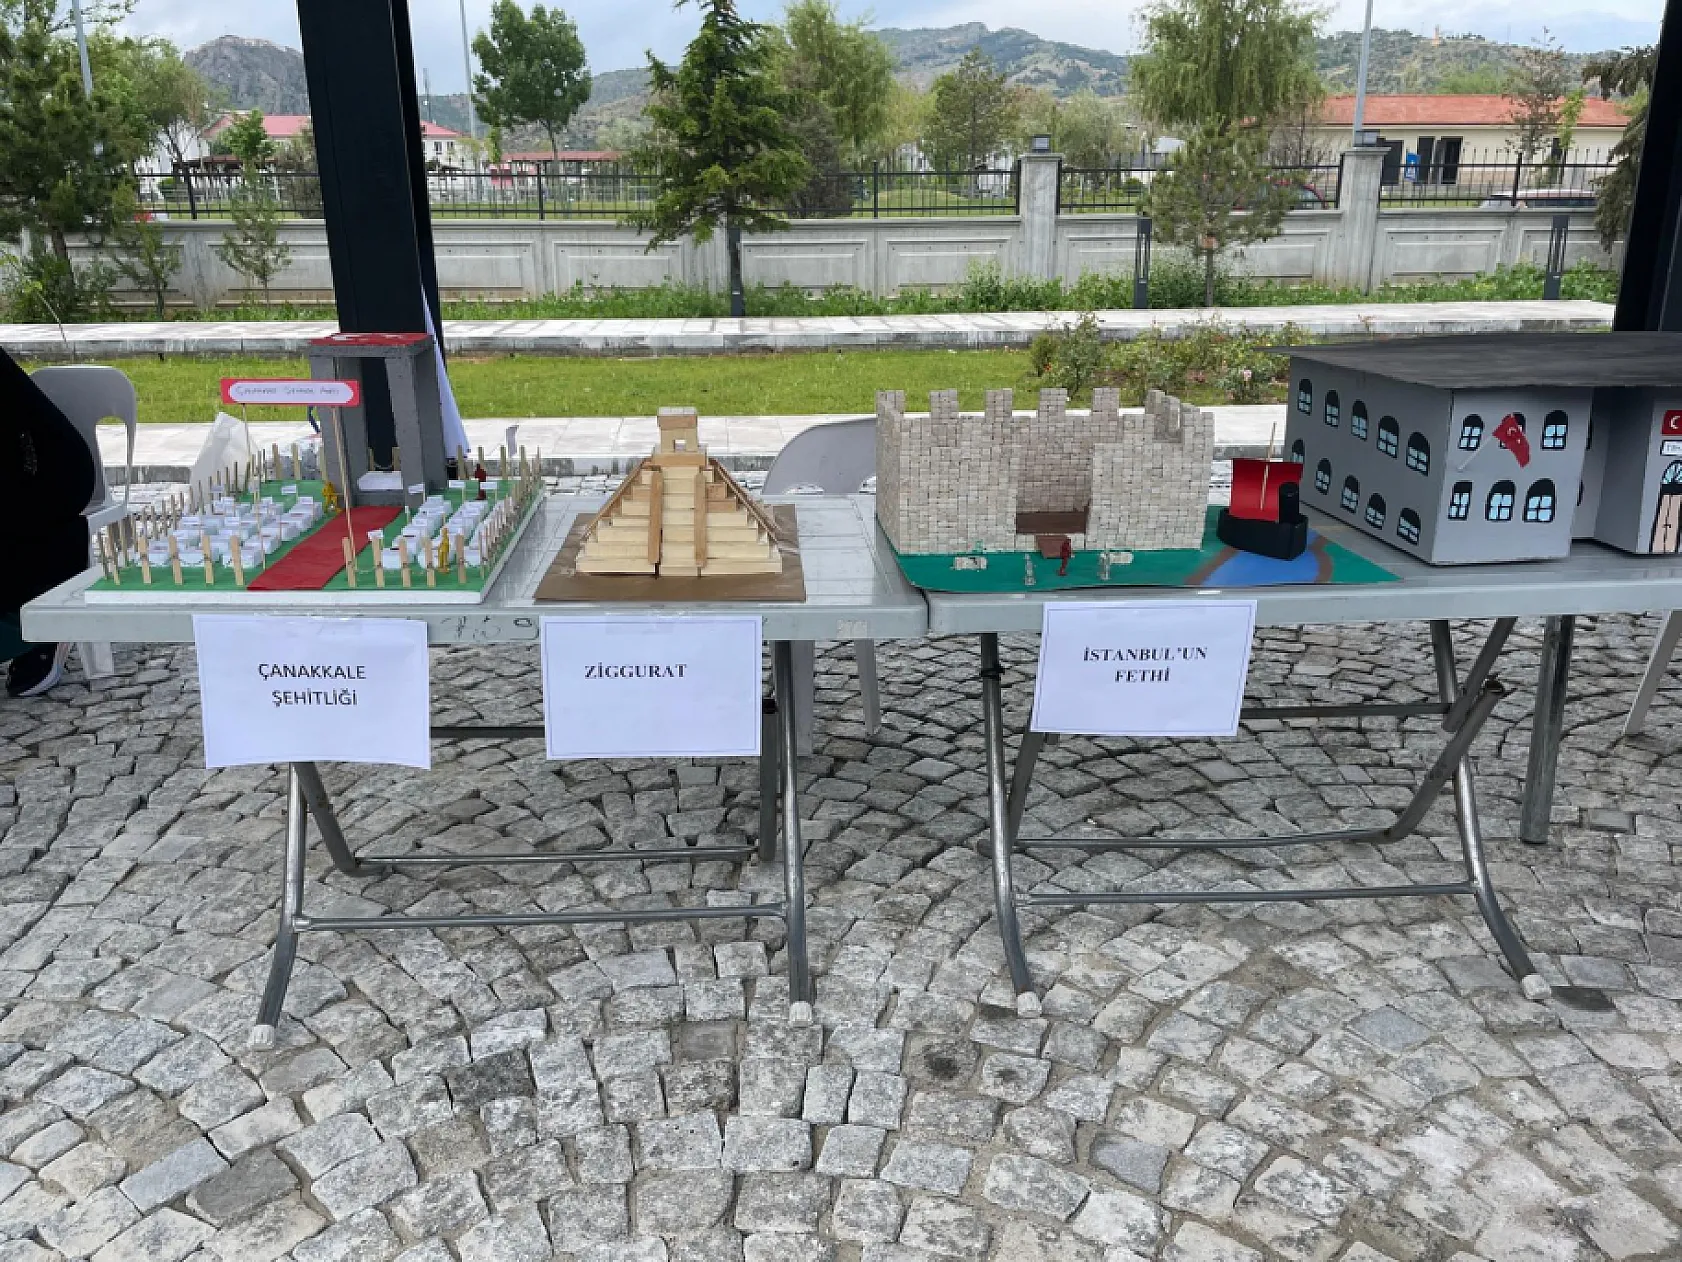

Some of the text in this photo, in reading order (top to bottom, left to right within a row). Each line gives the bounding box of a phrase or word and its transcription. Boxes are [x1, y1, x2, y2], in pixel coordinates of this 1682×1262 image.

[258, 663, 367, 681] ÇANAKKALE
[584, 661, 687, 679] ZİGGURAT
[1114, 666, 1171, 683] FETHİ
[272, 687, 357, 708] ŞEHİTLİĞİ
